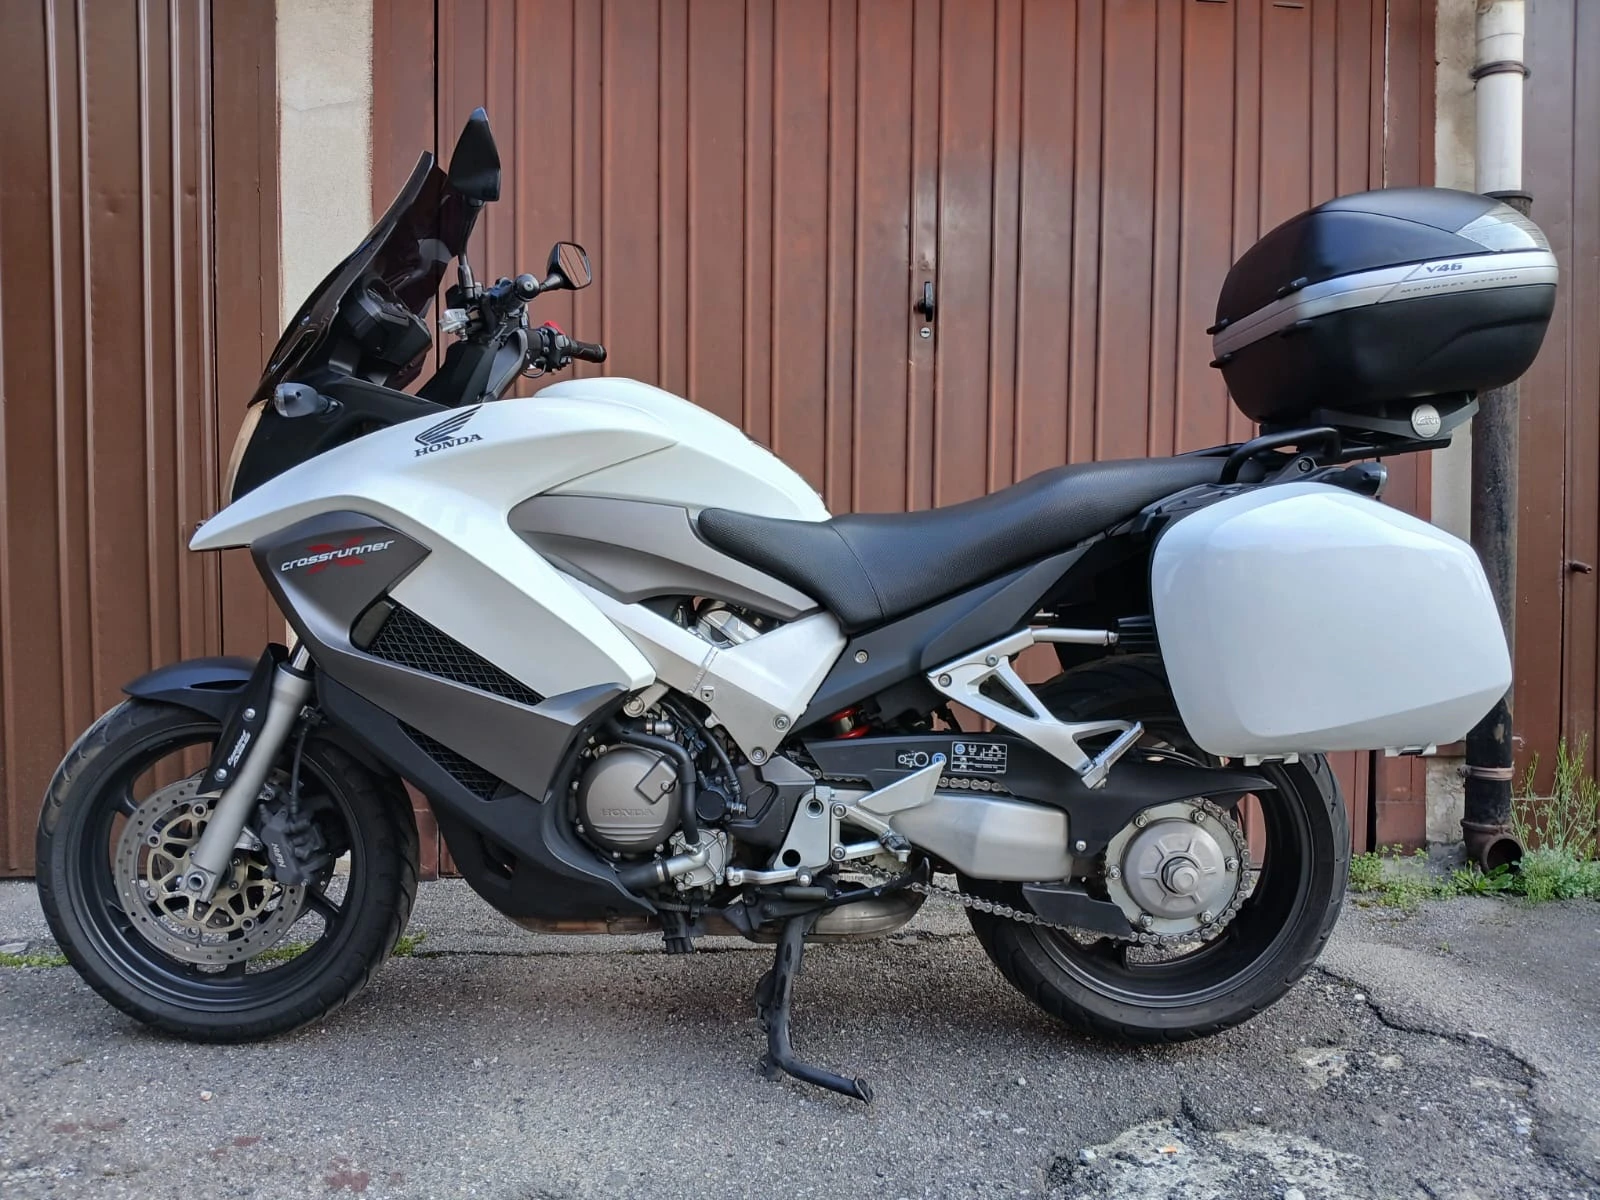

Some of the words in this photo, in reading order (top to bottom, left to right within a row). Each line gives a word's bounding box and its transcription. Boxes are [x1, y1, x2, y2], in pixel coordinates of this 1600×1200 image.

[1427, 263, 1463, 273] V46
[414, 433, 482, 457] HONDA
[280, 540, 395, 571] crossrunner
[602, 808, 656, 817] HONDA
